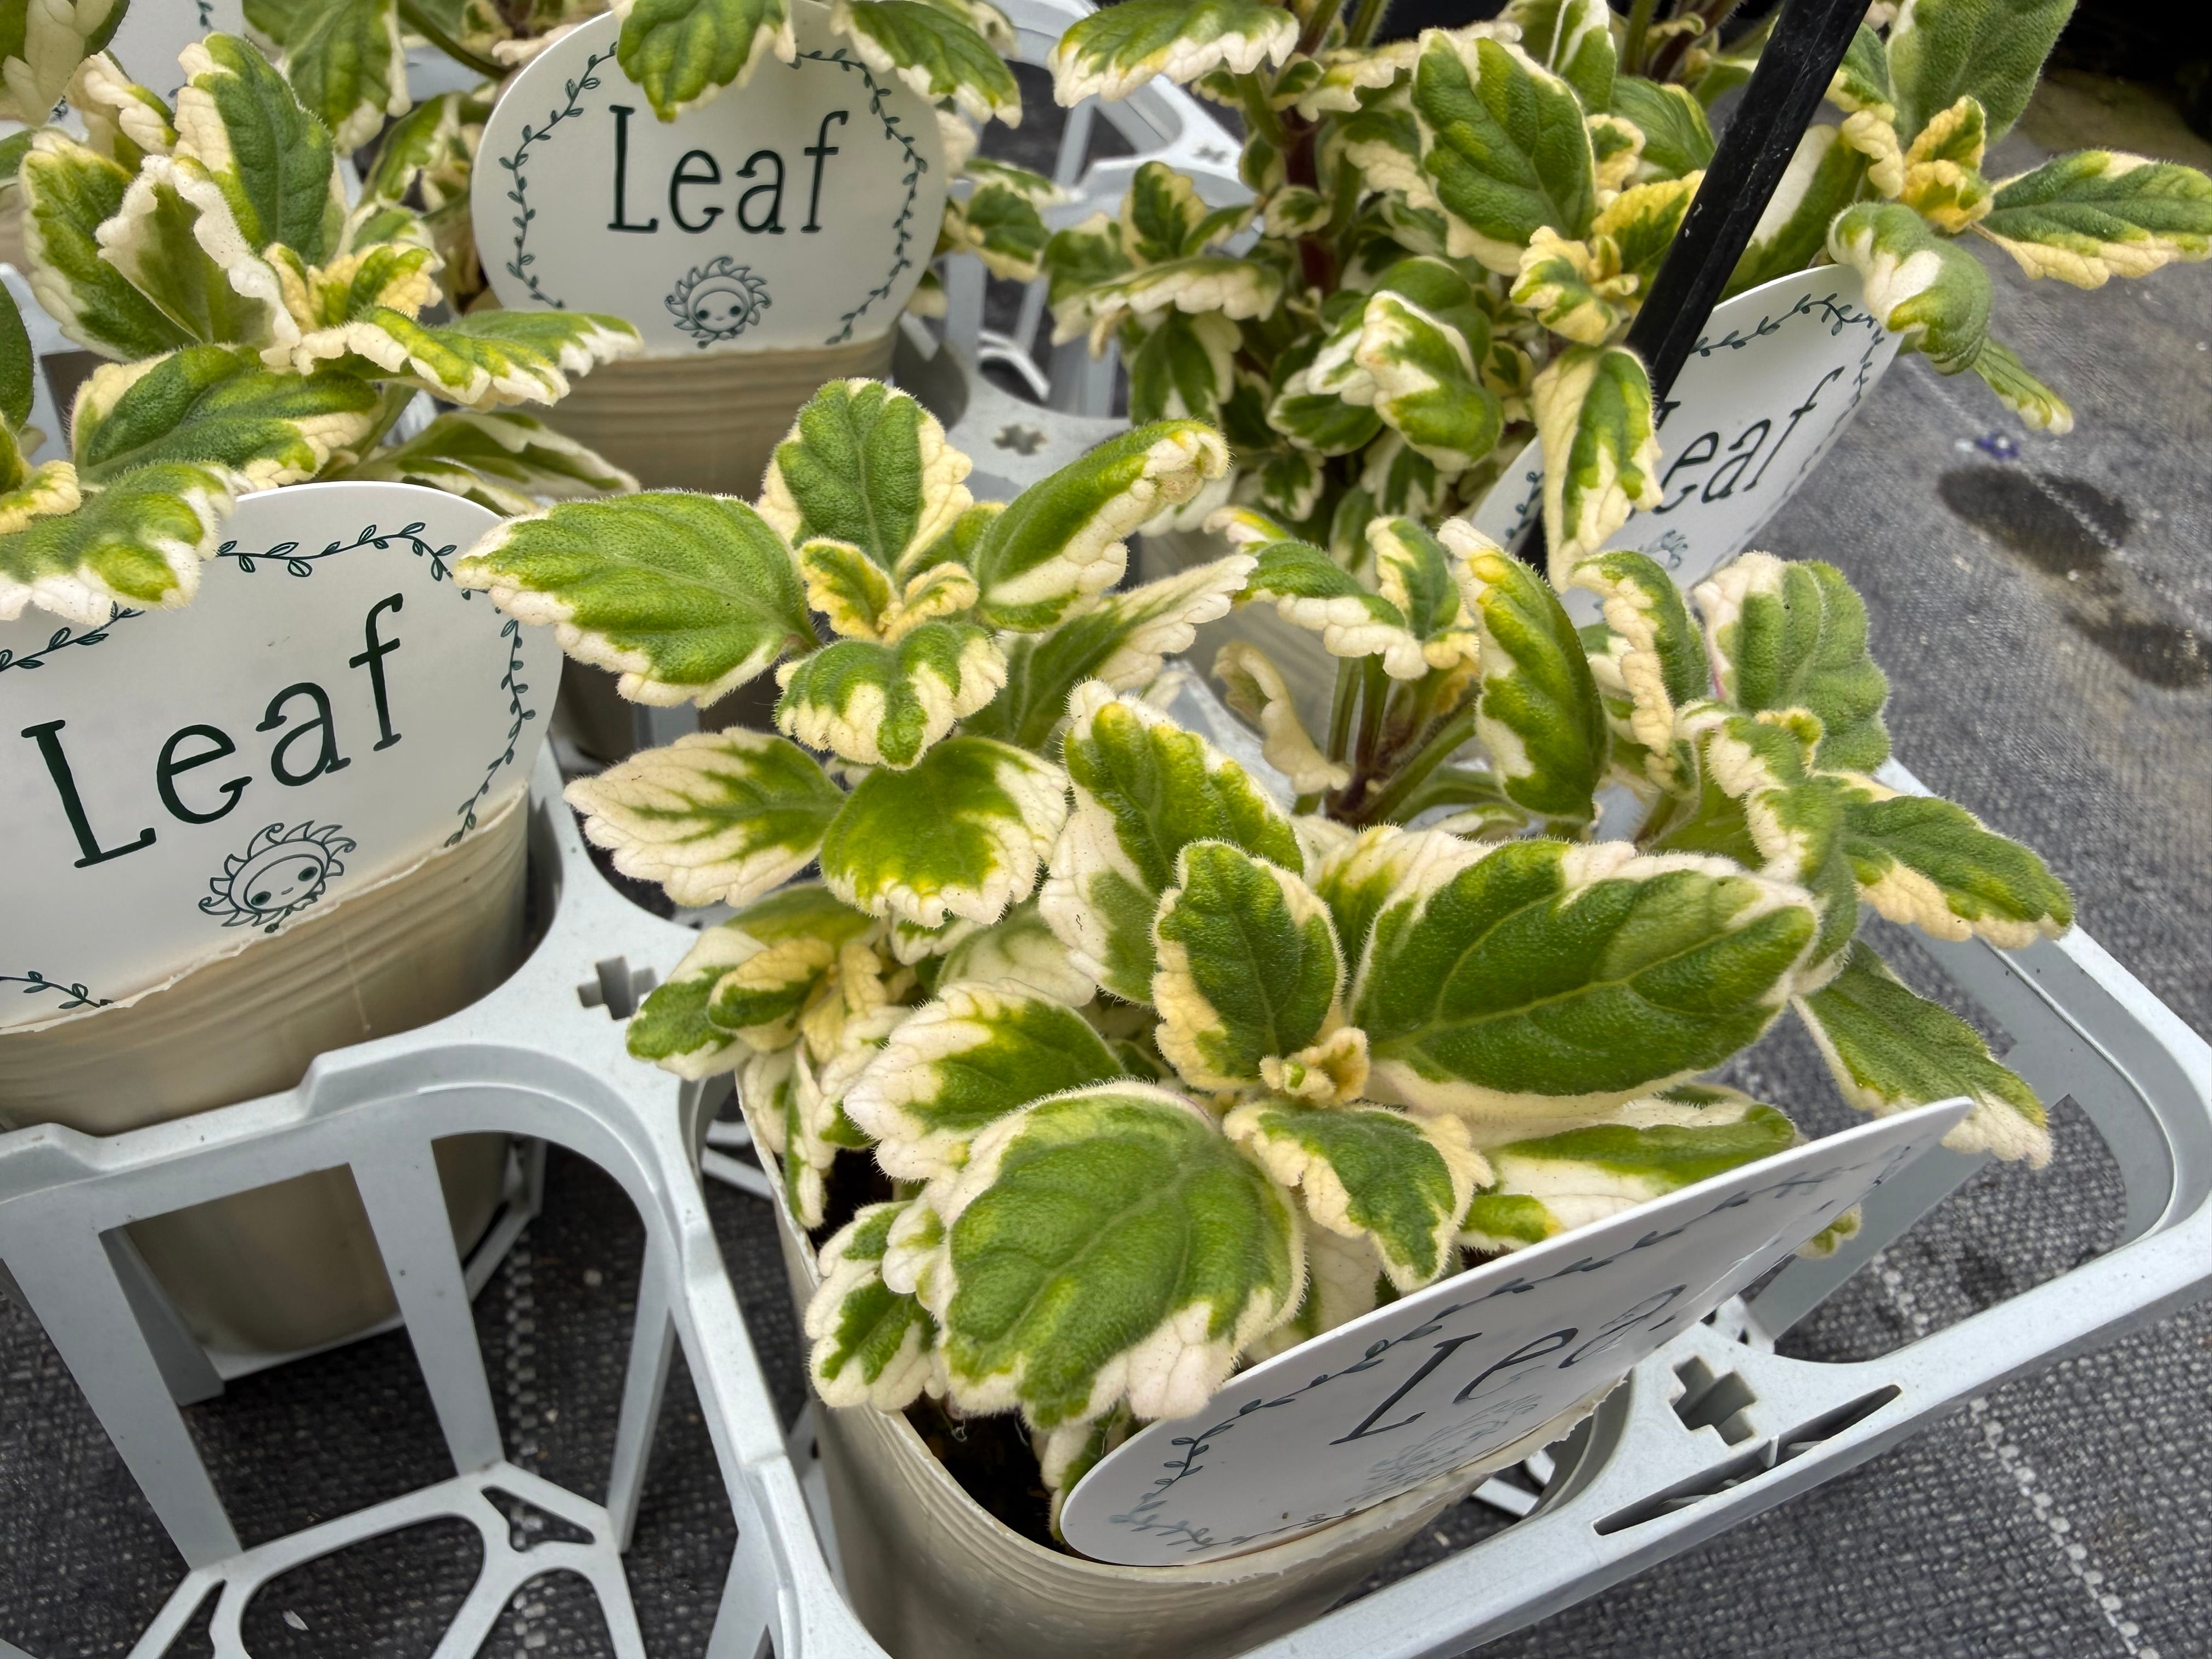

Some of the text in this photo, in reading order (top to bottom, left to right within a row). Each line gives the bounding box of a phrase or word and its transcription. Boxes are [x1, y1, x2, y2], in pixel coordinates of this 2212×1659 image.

[607, 104, 850, 235] Leaf
[1626, 366, 1845, 522] eaf
[21, 592, 403, 868] Leaf
[1328, 1284, 1688, 1446] Lea
